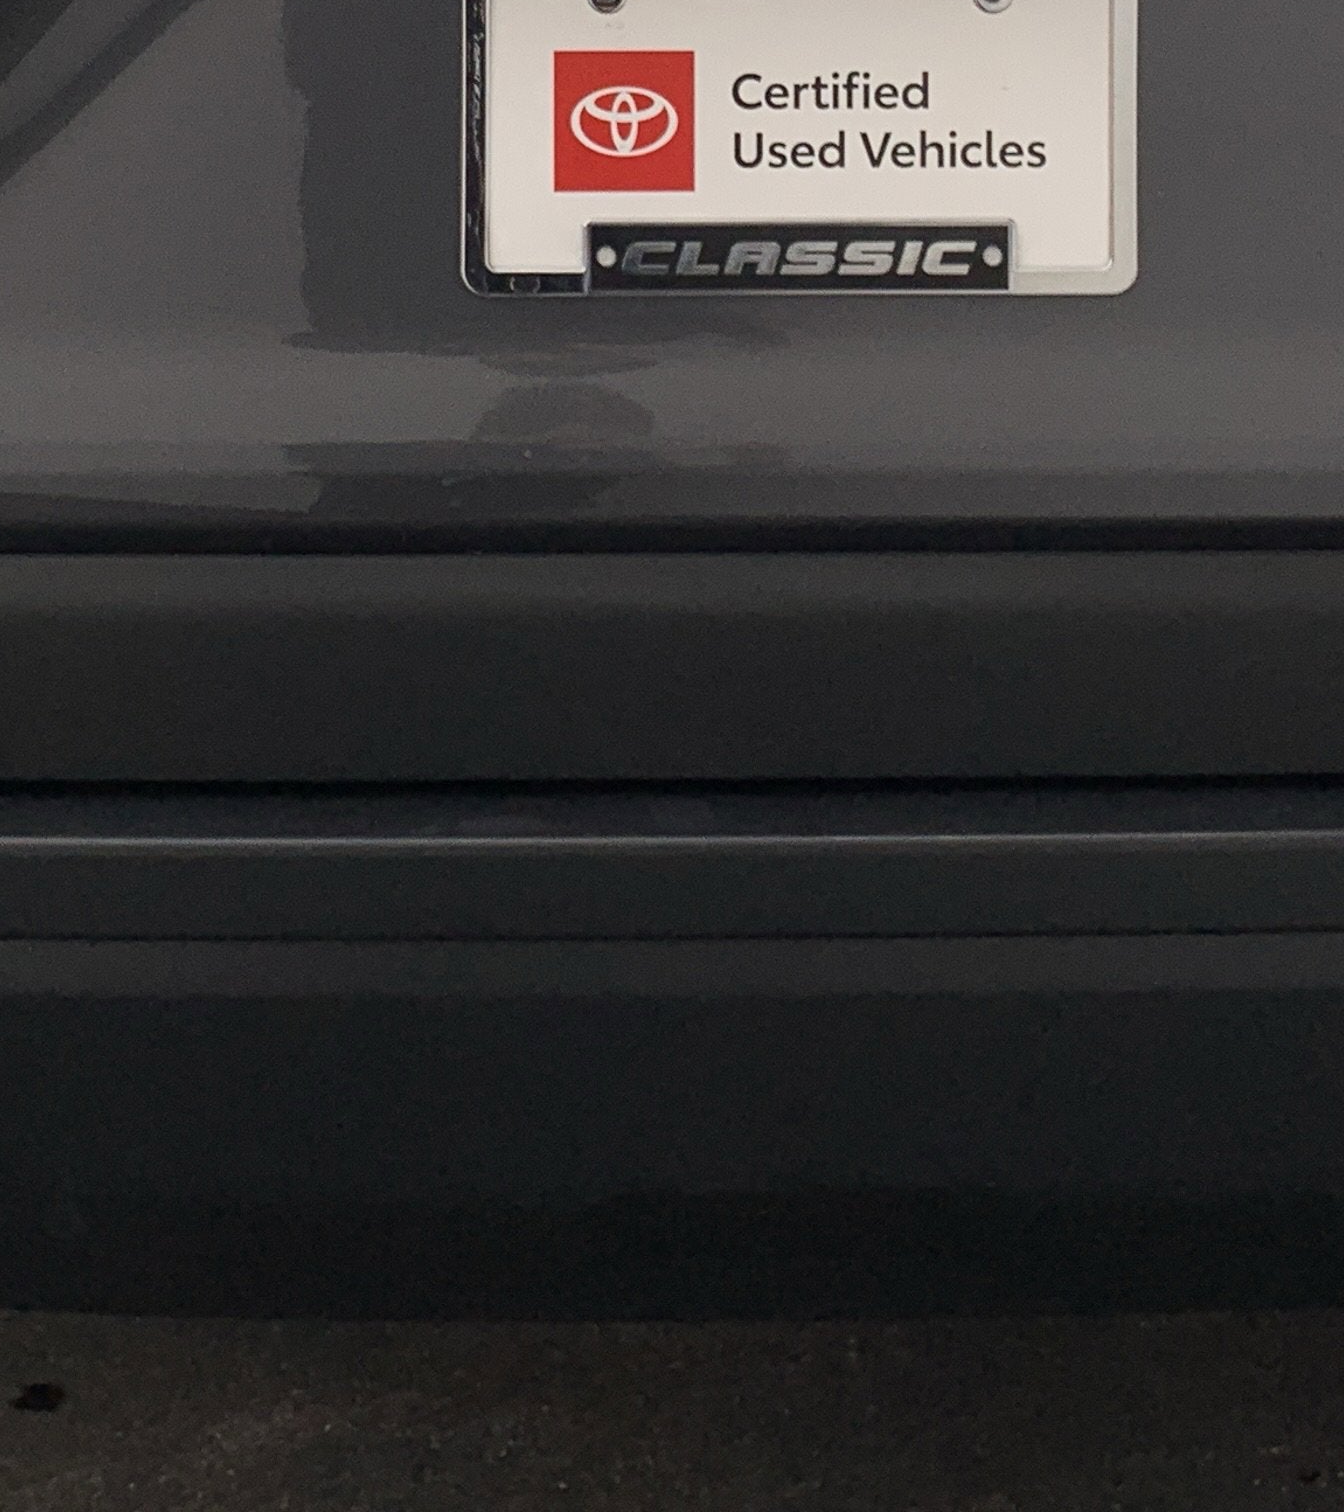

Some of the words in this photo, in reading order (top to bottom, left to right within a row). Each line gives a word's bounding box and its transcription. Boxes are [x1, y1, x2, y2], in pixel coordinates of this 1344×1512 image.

[732, 71, 929, 109] Certified
[733, 130, 846, 168] Used
[859, 130, 1047, 168] Vehicles
[621, 240, 977, 276] CLASSIC
